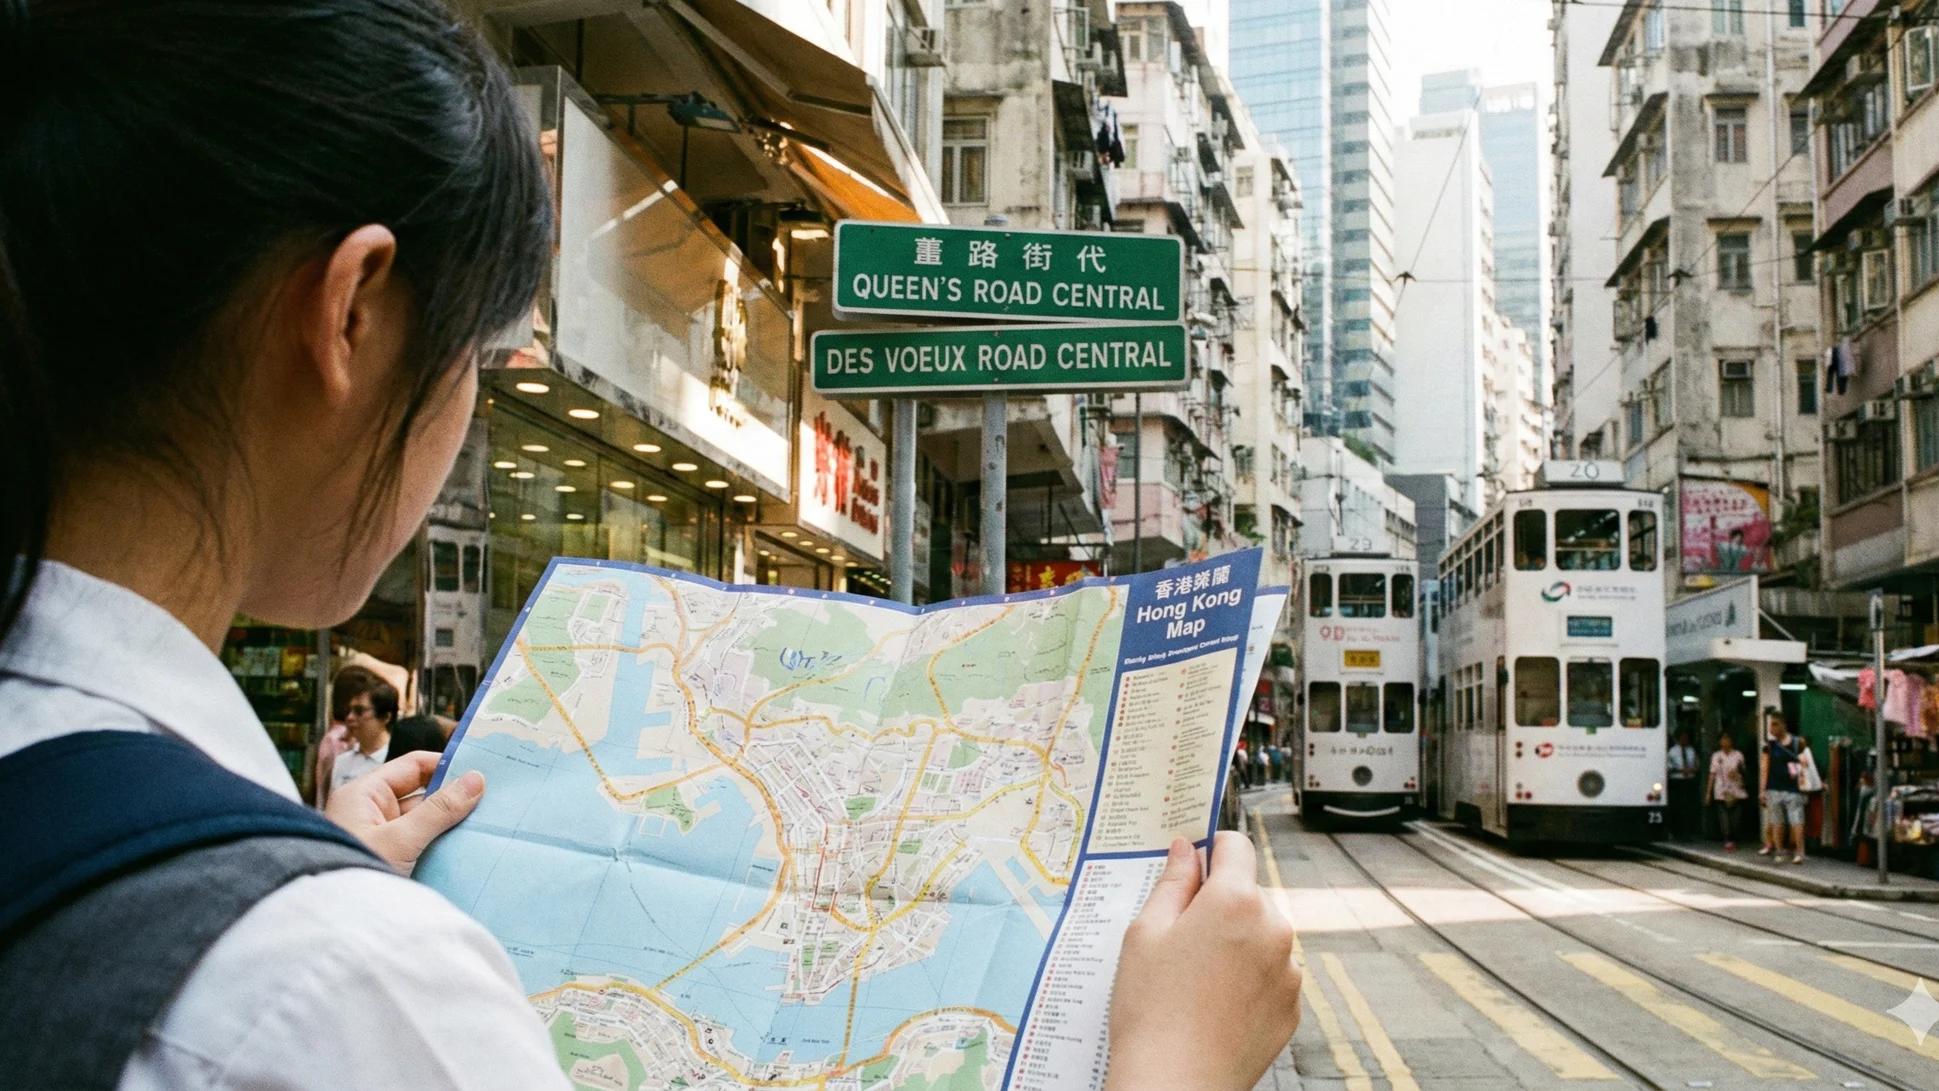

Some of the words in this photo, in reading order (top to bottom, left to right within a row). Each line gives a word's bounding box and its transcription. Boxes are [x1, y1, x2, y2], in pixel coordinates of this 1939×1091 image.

[852, 273, 962, 303] QUEEN'S
[974, 279, 1042, 305] ROAD
[1052, 282, 1165, 311] CENTRAL
[827, 348, 874, 374] DES
[885, 345, 967, 372] VOEUX
[978, 343, 1046, 370] ROAD
[1057, 341, 1171, 370] CENTRAL
[1137, 602, 1187, 624] Hong
[1191, 588, 1242, 613] Kong
[1166, 618, 1205, 640] Map
